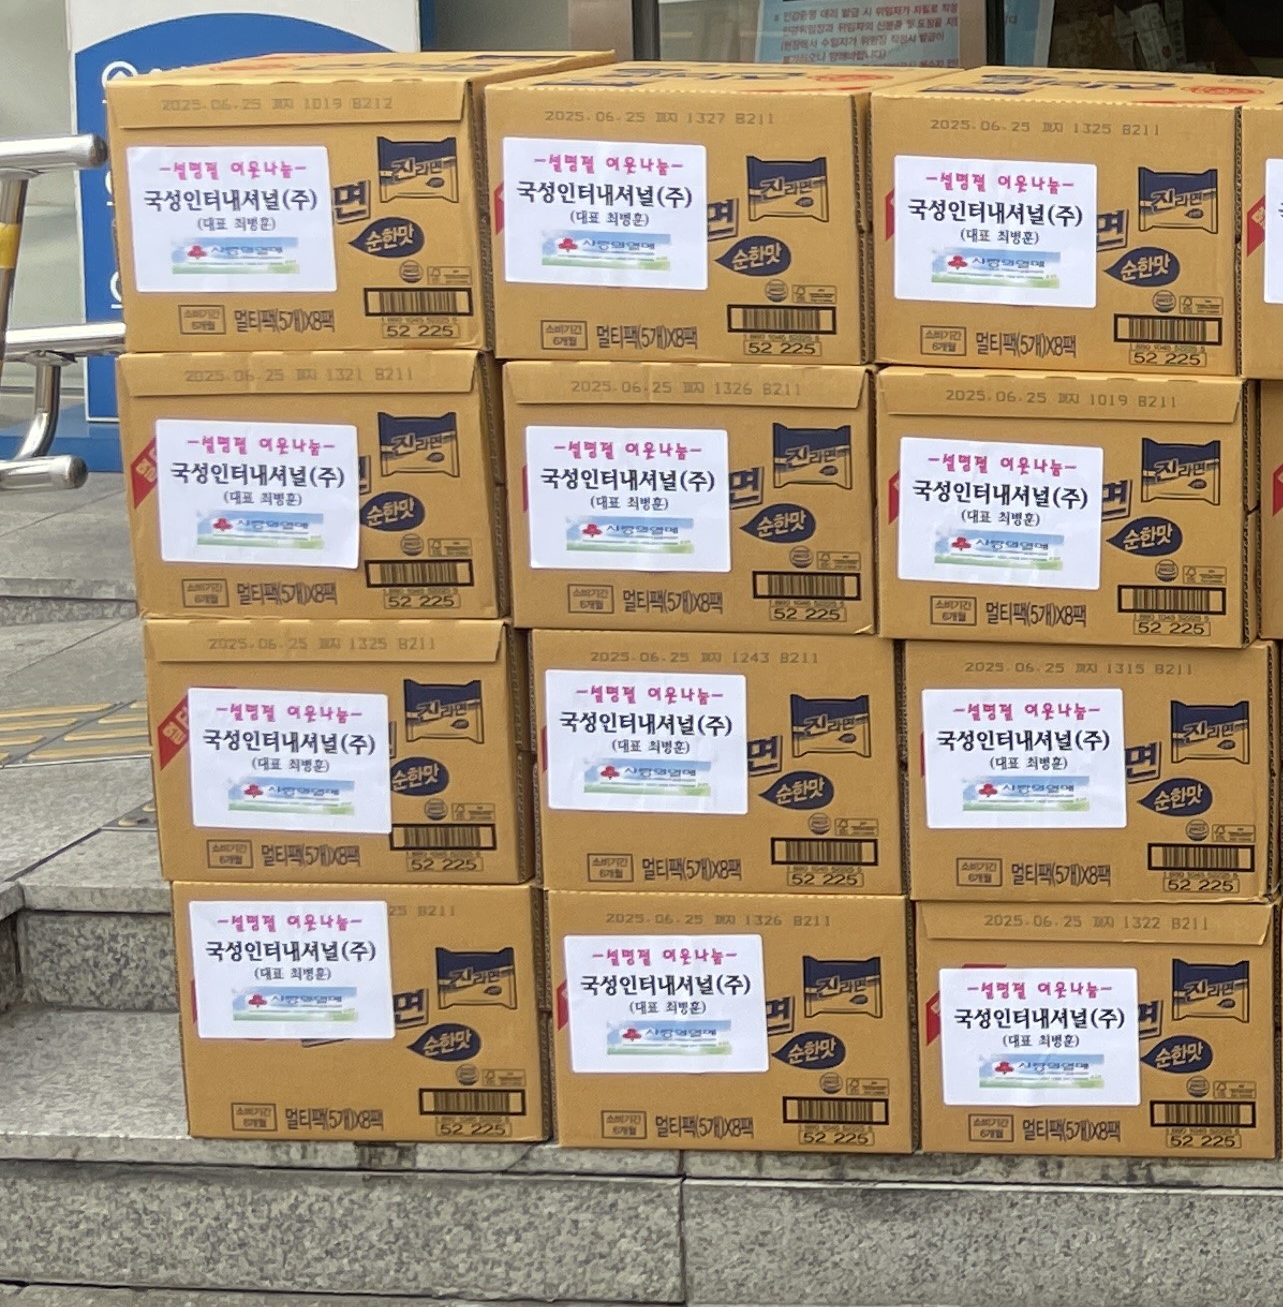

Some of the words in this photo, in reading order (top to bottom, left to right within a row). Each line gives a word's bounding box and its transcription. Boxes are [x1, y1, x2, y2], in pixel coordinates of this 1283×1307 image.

[143, 187, 317, 213] 국성인터내셔널(주)
[516, 179, 693, 210] 국성인터내셔널(주)
[907, 197, 1083, 229] 국성인터내셔널(주)
[960, 229, 991, 243] (대표
[1121, 254, 1170, 281] 순한맛
[1134, 353, 1159, 364] 52
[1165, 353, 1201, 366] 225
[912, 478, 1088, 511] 국성인터내셔널(주)
[559, 710, 733, 739] 국성인터내셔널(주)
[205, 939, 376, 964] 국성인터내셔널(주)
